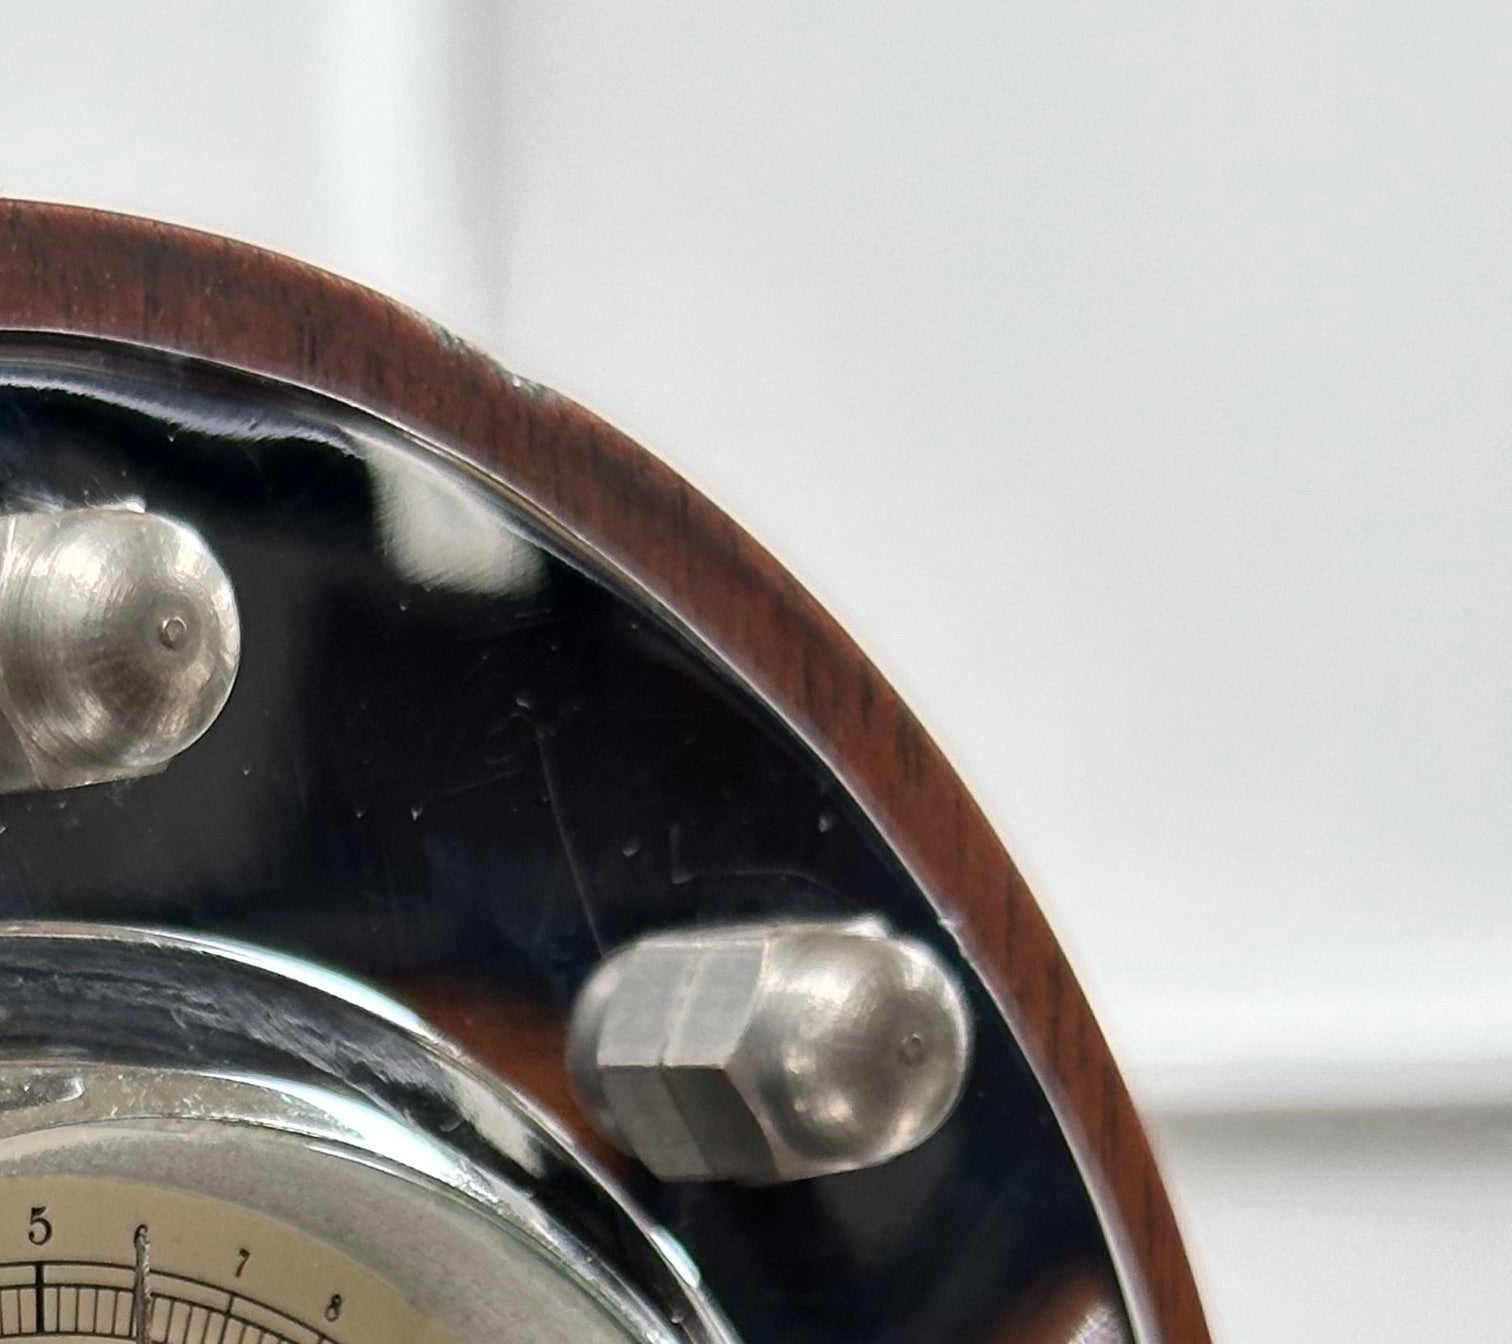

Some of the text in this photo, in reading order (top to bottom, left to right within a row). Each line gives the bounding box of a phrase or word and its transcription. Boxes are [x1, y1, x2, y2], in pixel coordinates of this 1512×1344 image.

[28, 1206, 53, 1246] 5
[233, 1248, 251, 1278] 7
[323, 1293, 344, 1323] 8
